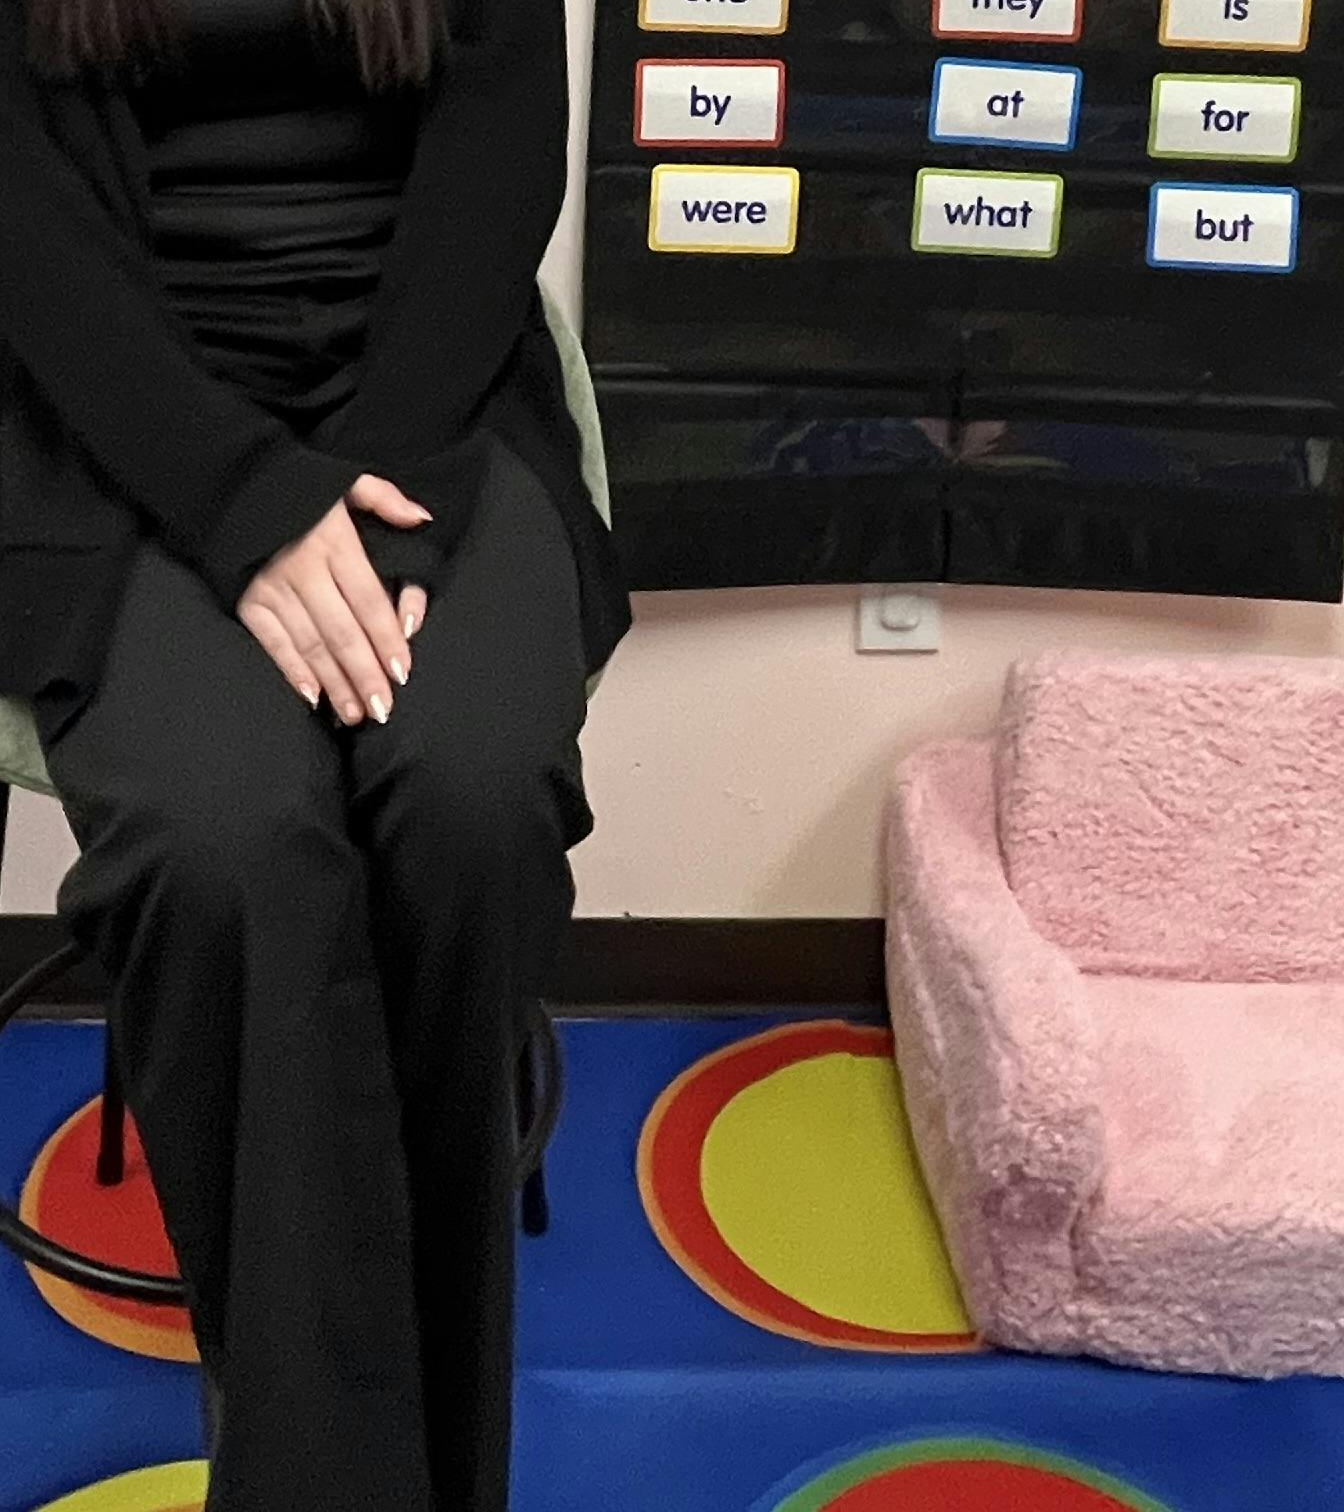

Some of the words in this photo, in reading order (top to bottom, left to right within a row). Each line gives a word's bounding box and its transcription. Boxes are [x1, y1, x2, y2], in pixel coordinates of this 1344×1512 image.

[689, 87, 732, 125] by
[987, 90, 1024, 118] at
[1201, 101, 1249, 133] for
[682, 196, 768, 225] were
[944, 198, 1032, 230] what
[1194, 211, 1253, 242] but
